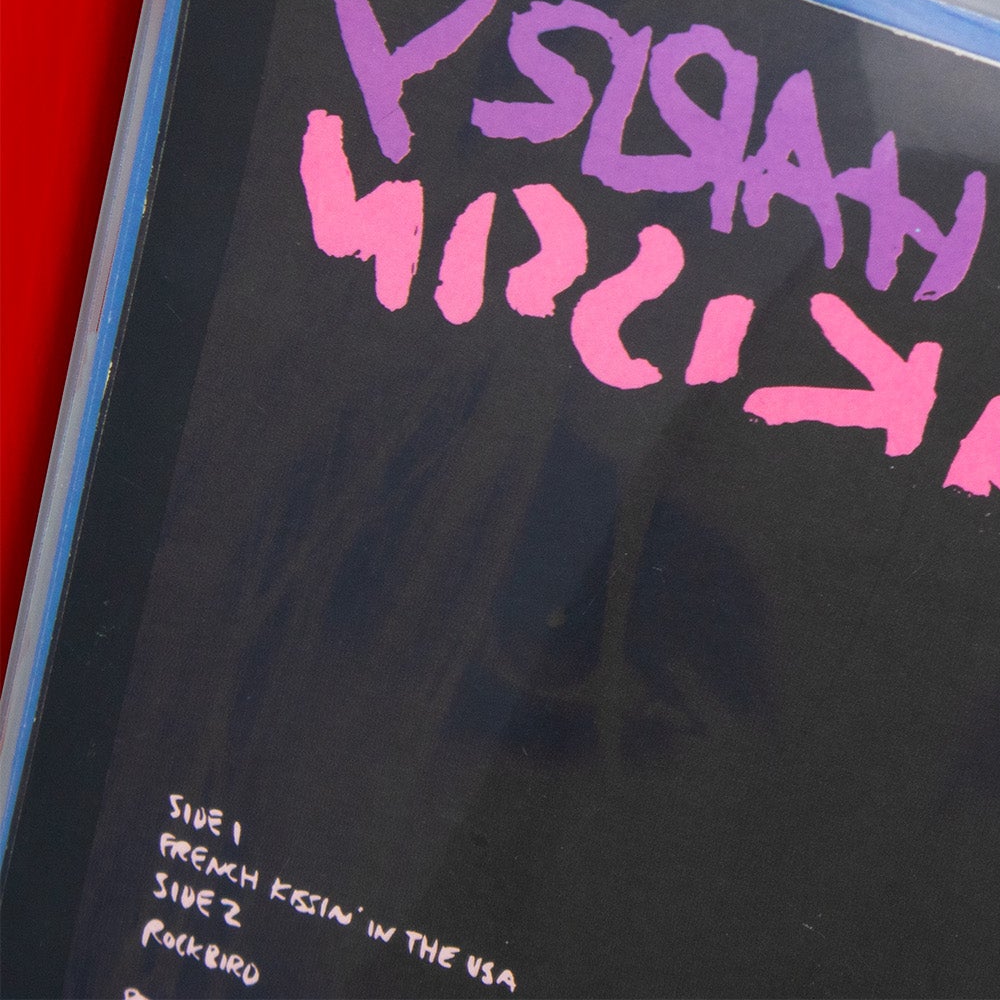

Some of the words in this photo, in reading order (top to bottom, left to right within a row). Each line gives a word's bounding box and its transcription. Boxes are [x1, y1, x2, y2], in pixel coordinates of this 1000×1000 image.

[169, 793, 224, 836] SIDE
[233, 820, 242, 846] 1
[153, 871, 213, 918] SIDE
[220, 897, 242, 928] 2
[159, 832, 259, 890] FRENCH
[367, 919, 397, 943] IN
[405, 930, 461, 969] THE
[466, 954, 518, 993] USA
[141, 918, 260, 986] ROCKBIRD
